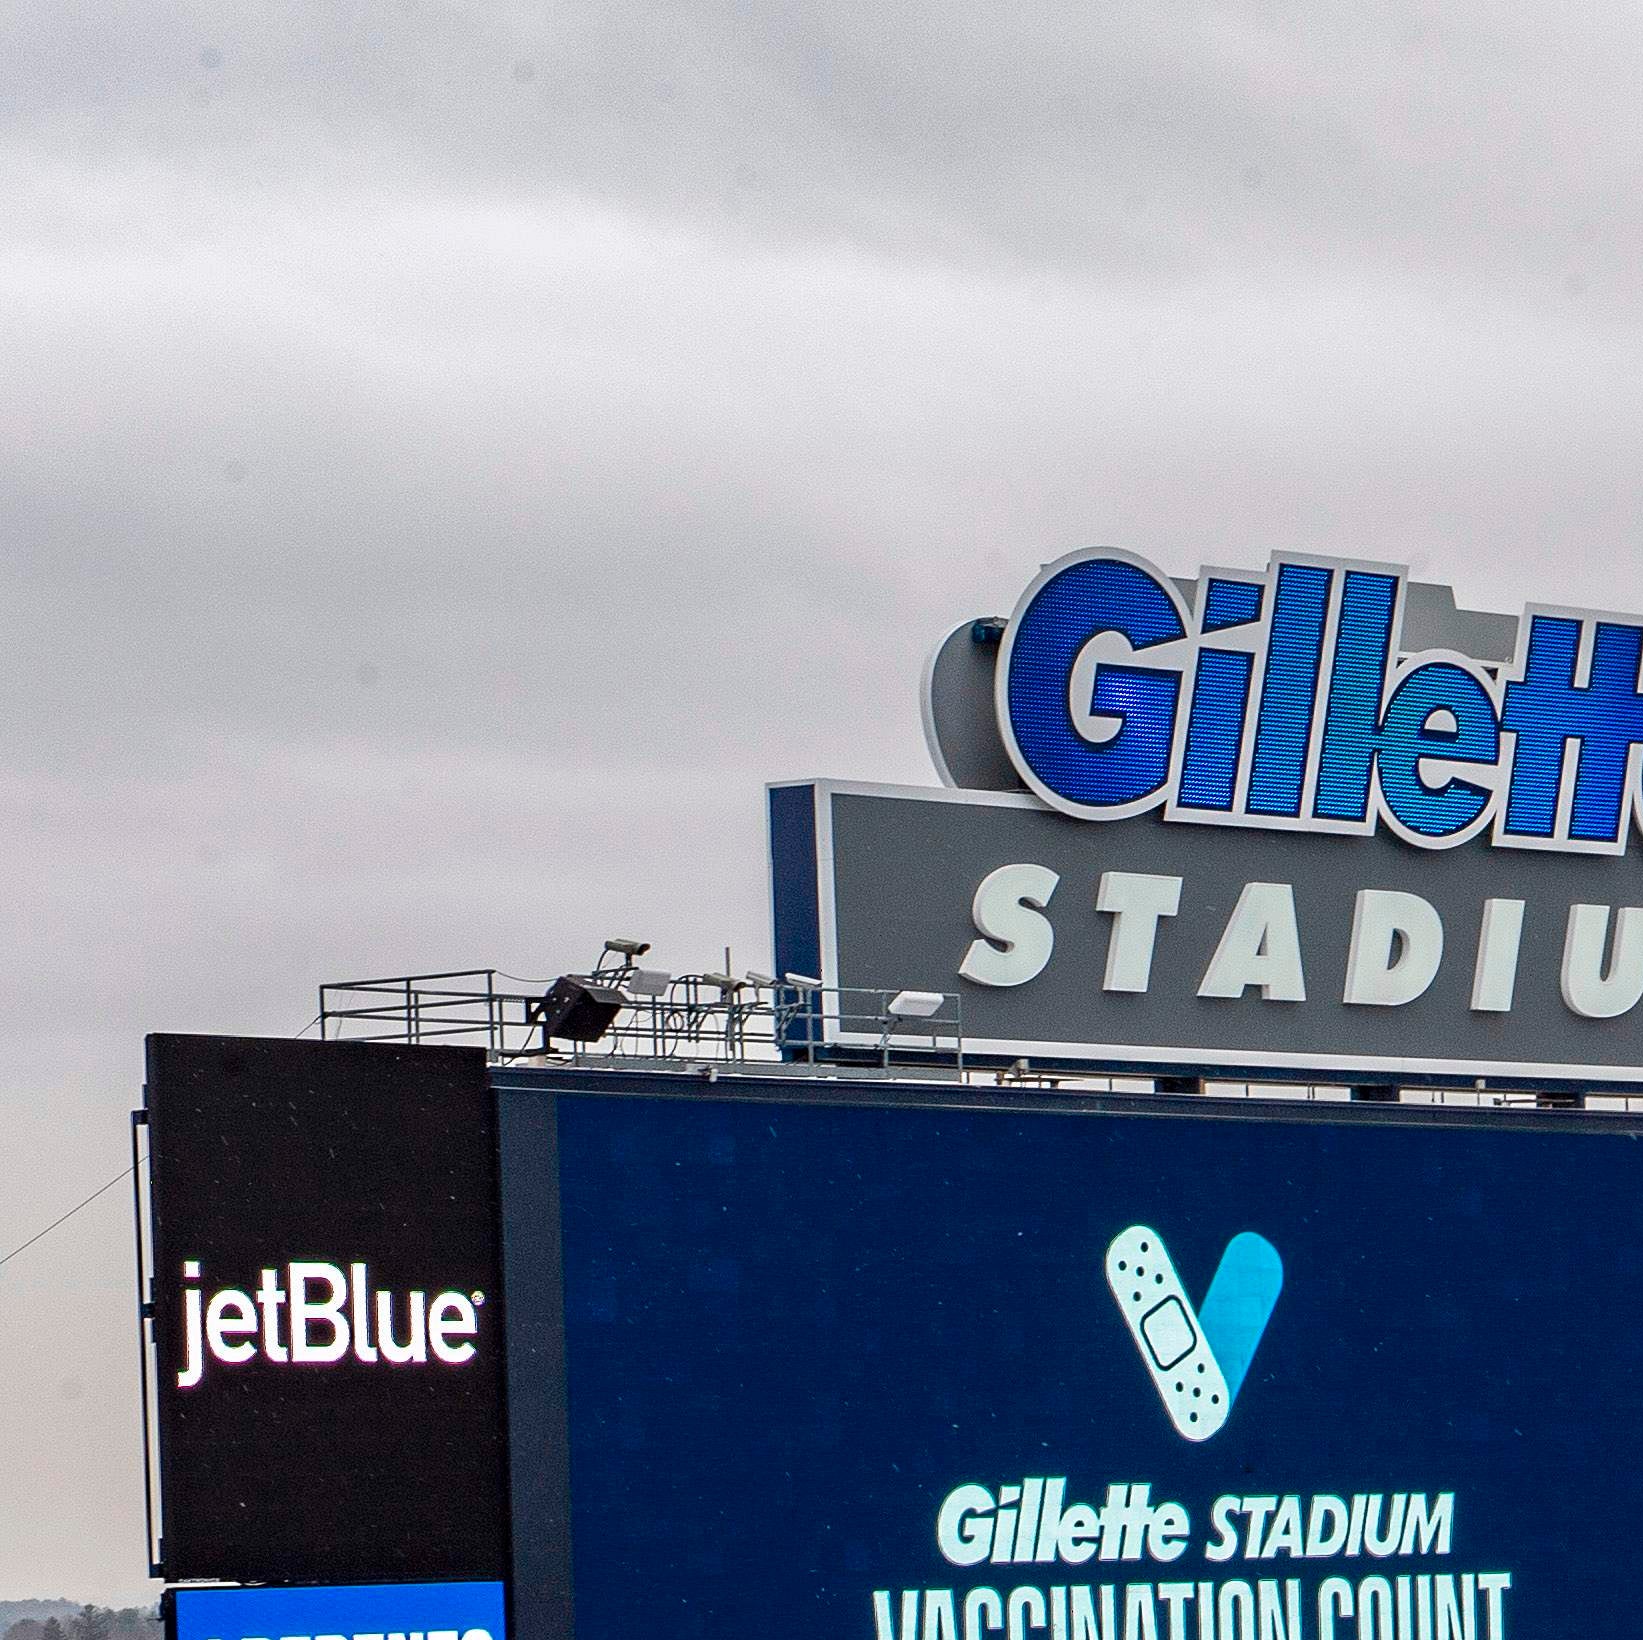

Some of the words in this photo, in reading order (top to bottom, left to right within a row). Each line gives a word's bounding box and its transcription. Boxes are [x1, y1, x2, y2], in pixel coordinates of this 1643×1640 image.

[176, 1260, 478, 1388] jetBlue
[937, 1478, 1189, 1565] Gillette
[1205, 1492, 1455, 1561] STADIUM
